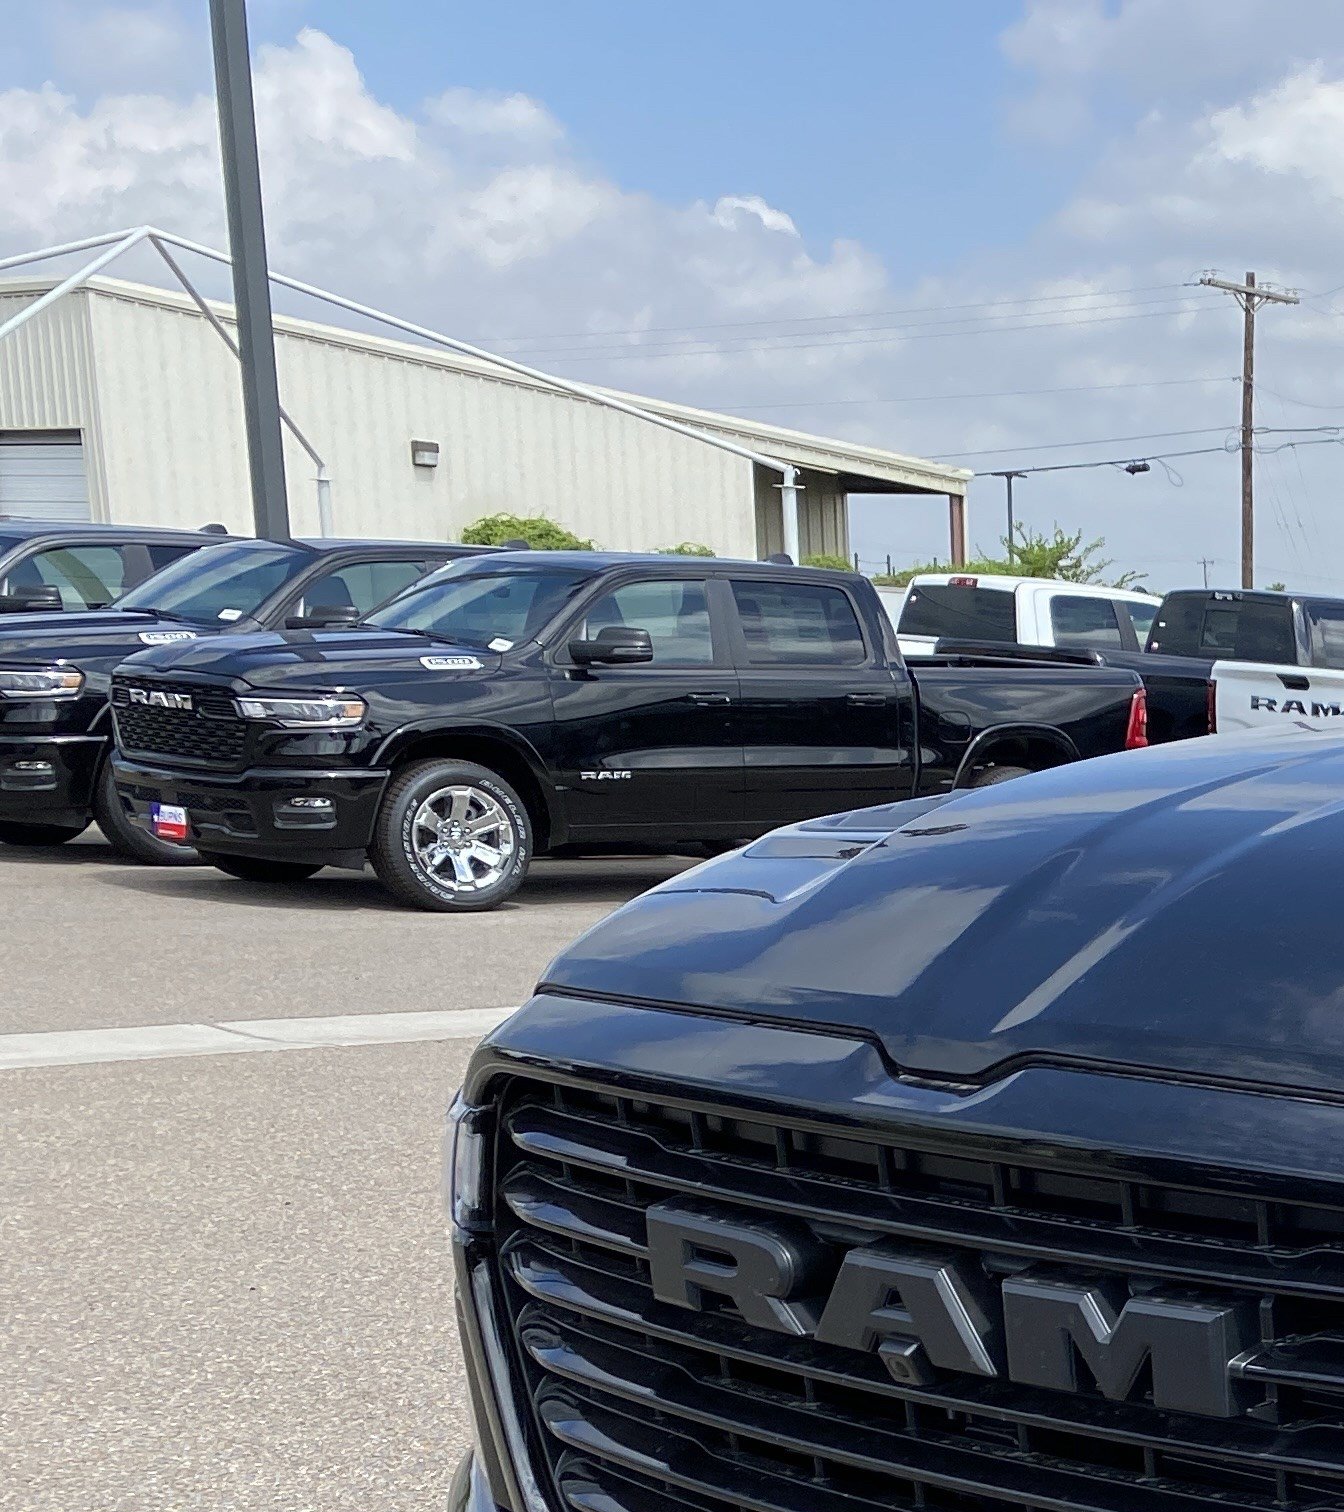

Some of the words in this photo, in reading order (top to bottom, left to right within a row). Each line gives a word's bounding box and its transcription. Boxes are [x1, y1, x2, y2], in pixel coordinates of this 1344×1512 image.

[129, 688, 193, 710] RAM
[1250, 695, 1341, 717] RAM
[580, 770, 632, 780] RAM
[645, 1201, 1240, 1418] RAM
